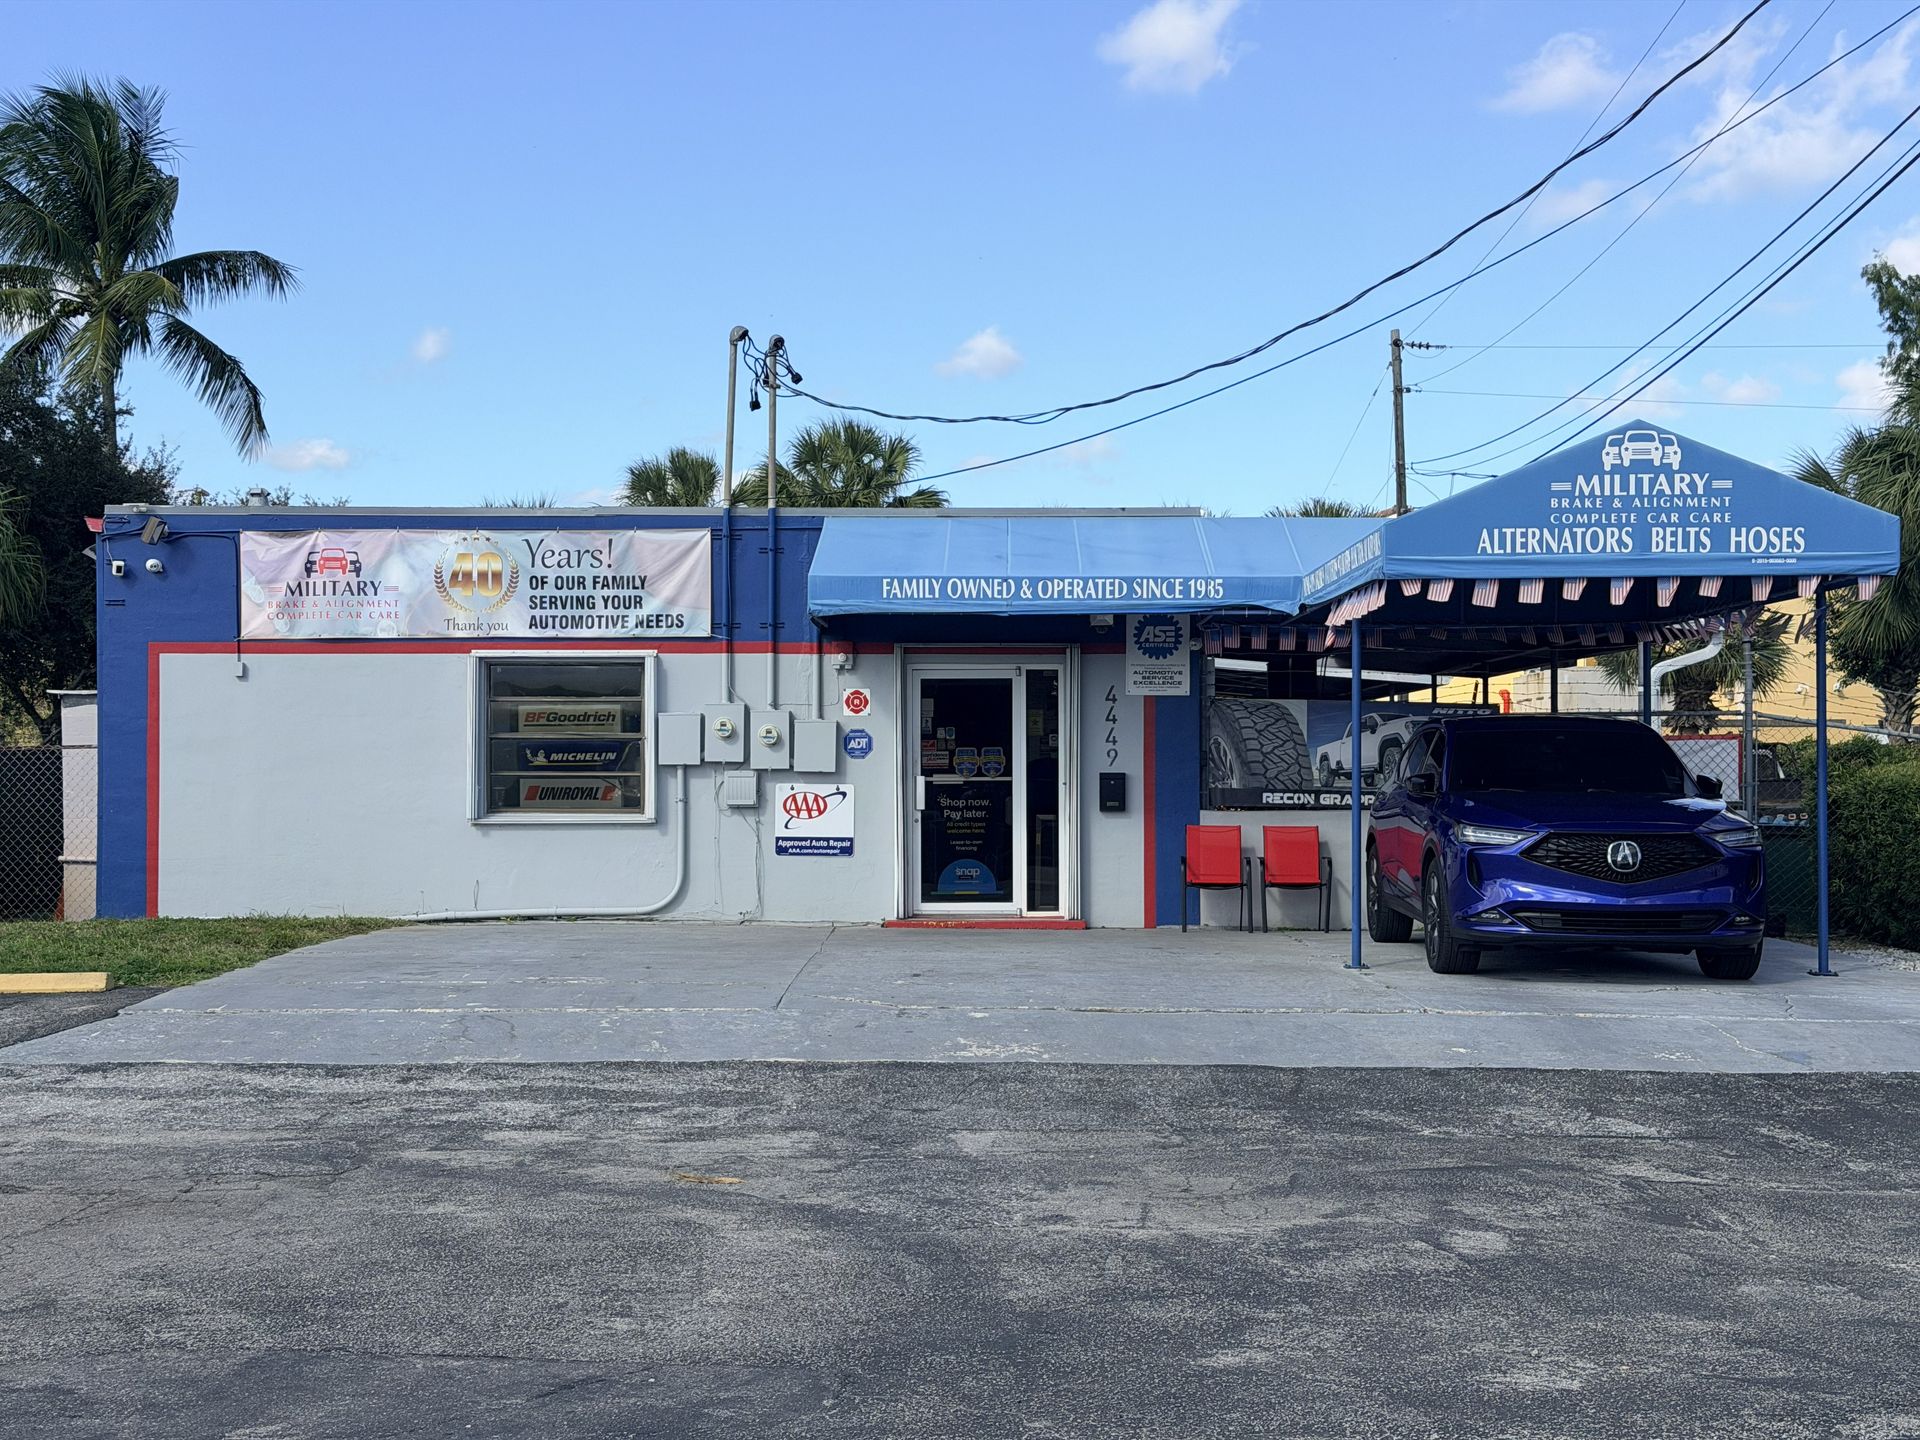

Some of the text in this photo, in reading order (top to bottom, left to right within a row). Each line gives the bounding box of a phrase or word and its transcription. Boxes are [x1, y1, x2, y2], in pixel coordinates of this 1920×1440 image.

[1574, 473, 1710, 496] MILITARY
[1550, 497, 1732, 508] BRAKE & ALIGNMENT
[1550, 512, 1732, 524] COMPLETE CAR CARE
[1477, 526, 1805, 554] ALTERNATORS BELTS HOSES
[521, 538, 613, 569] Years!
[449, 552, 503, 597] 40
[284, 580, 382, 597] MILITARY
[529, 575, 648, 591] OF OUR FAMILY
[882, 578, 1224, 598] FAMILY OWNED & OPERATED SINCE 1985
[268, 600, 400, 609] BRAKE & ALIGNMENT
[529, 595, 644, 610] SERVING YOUR
[267, 611, 400, 620] COMPLETE CAR CARE
[528, 614, 685, 630] AUTOMOTIVE NEEDS
[444, 617, 510, 635] Thank you
[1138, 626, 1176, 642] ASE
[524, 711, 617, 723] BFGoodrich
[1432, 707, 1493, 715] NITTO
[1105, 684, 1119, 767] 4449
[848, 738, 868, 749] ADT
[549, 752, 617, 761] MICHELIN
[538, 785, 601, 801] UNIROYAL
[1262, 792, 1315, 804] RECON
[787, 792, 824, 819] AAA
[940, 797, 966, 808] Shop
[943, 809, 989, 820] Pay later.
[778, 840, 810, 848] Approved
[829, 840, 851, 848] Repair
[955, 867, 980, 878] snap
